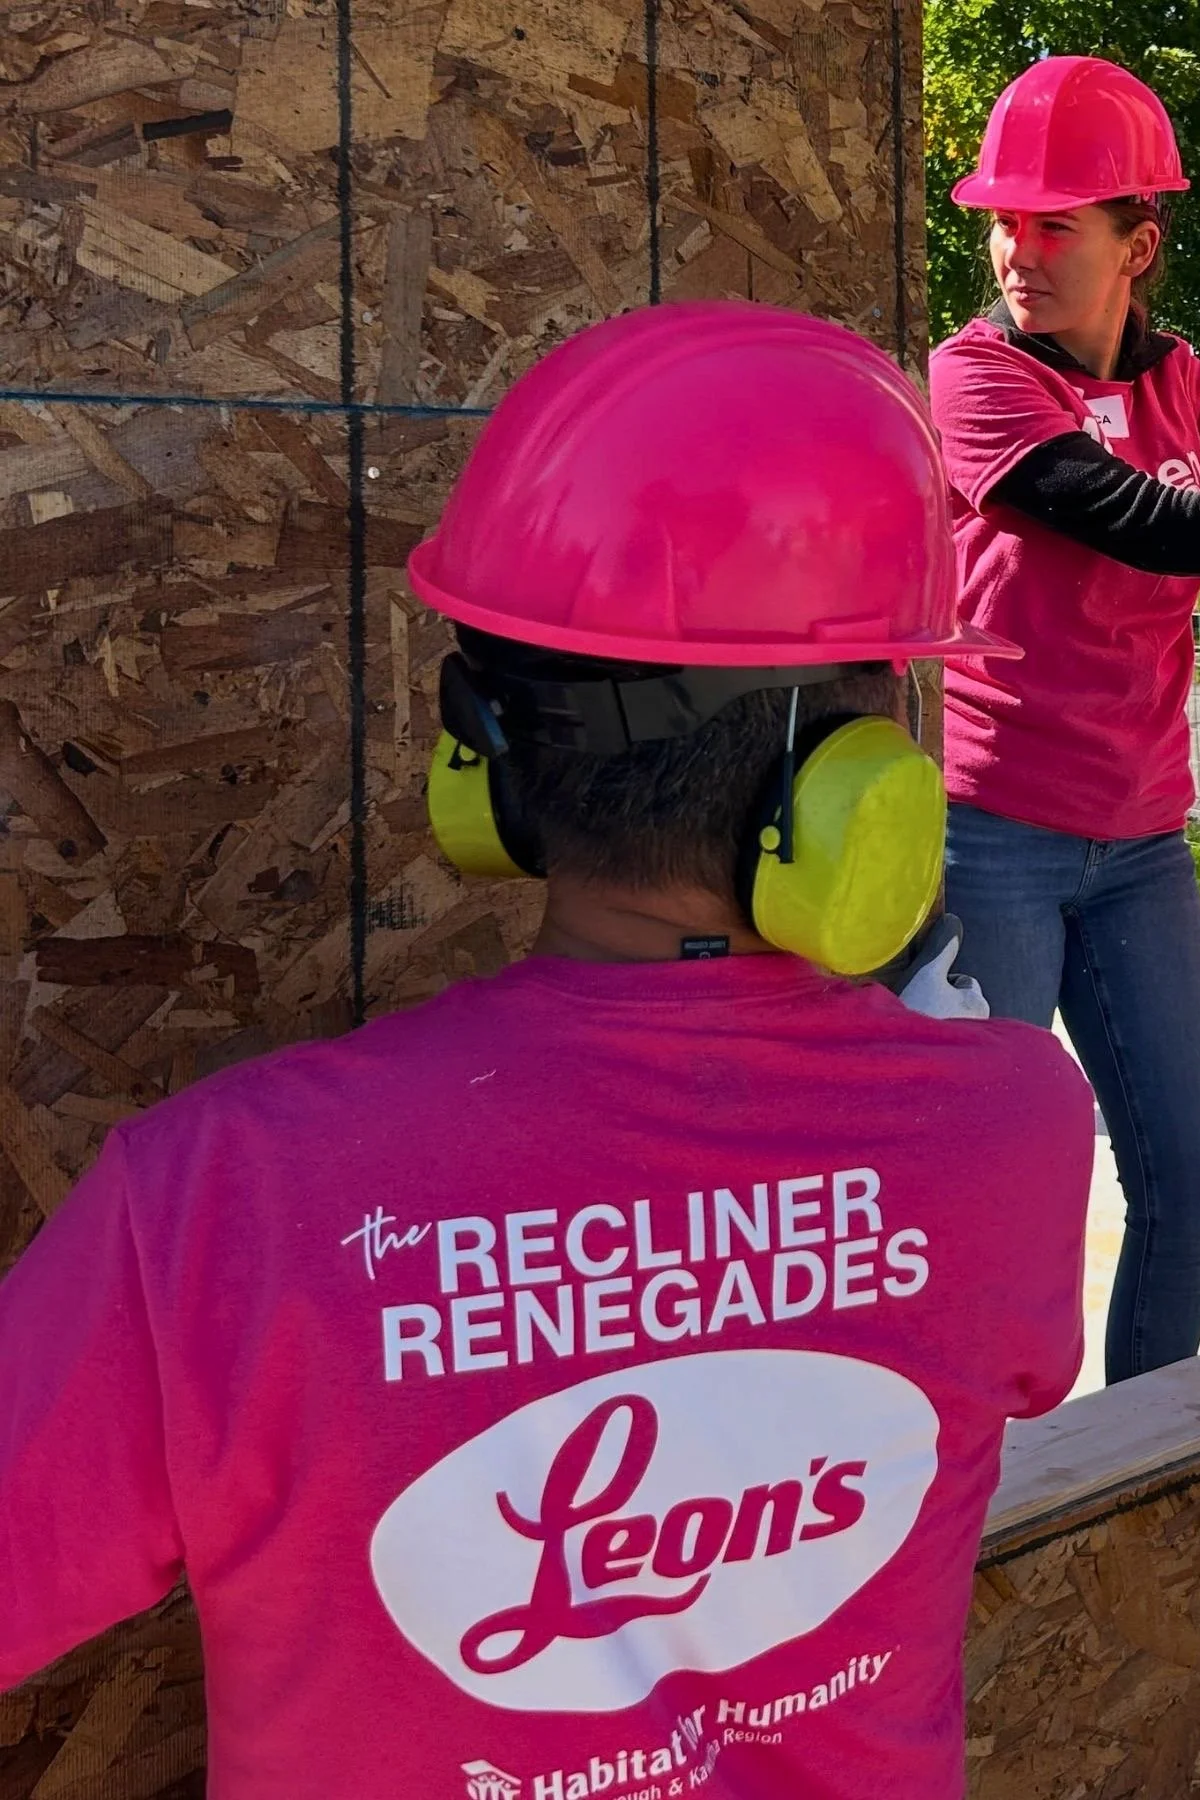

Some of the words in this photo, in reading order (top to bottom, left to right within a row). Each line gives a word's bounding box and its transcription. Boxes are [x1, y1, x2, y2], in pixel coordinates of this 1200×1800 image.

[341, 1205, 432, 1280] the
[437, 1166, 882, 1293] RECLINER
[382, 1227, 930, 1382] RENEGADES
[459, 1393, 867, 1675] Leon's
[534, 1729, 687, 1800] Habitat
[716, 1650, 892, 1728] Humanity
[668, 1777, 683, 1796] &
[723, 1727, 783, 1746] Region
